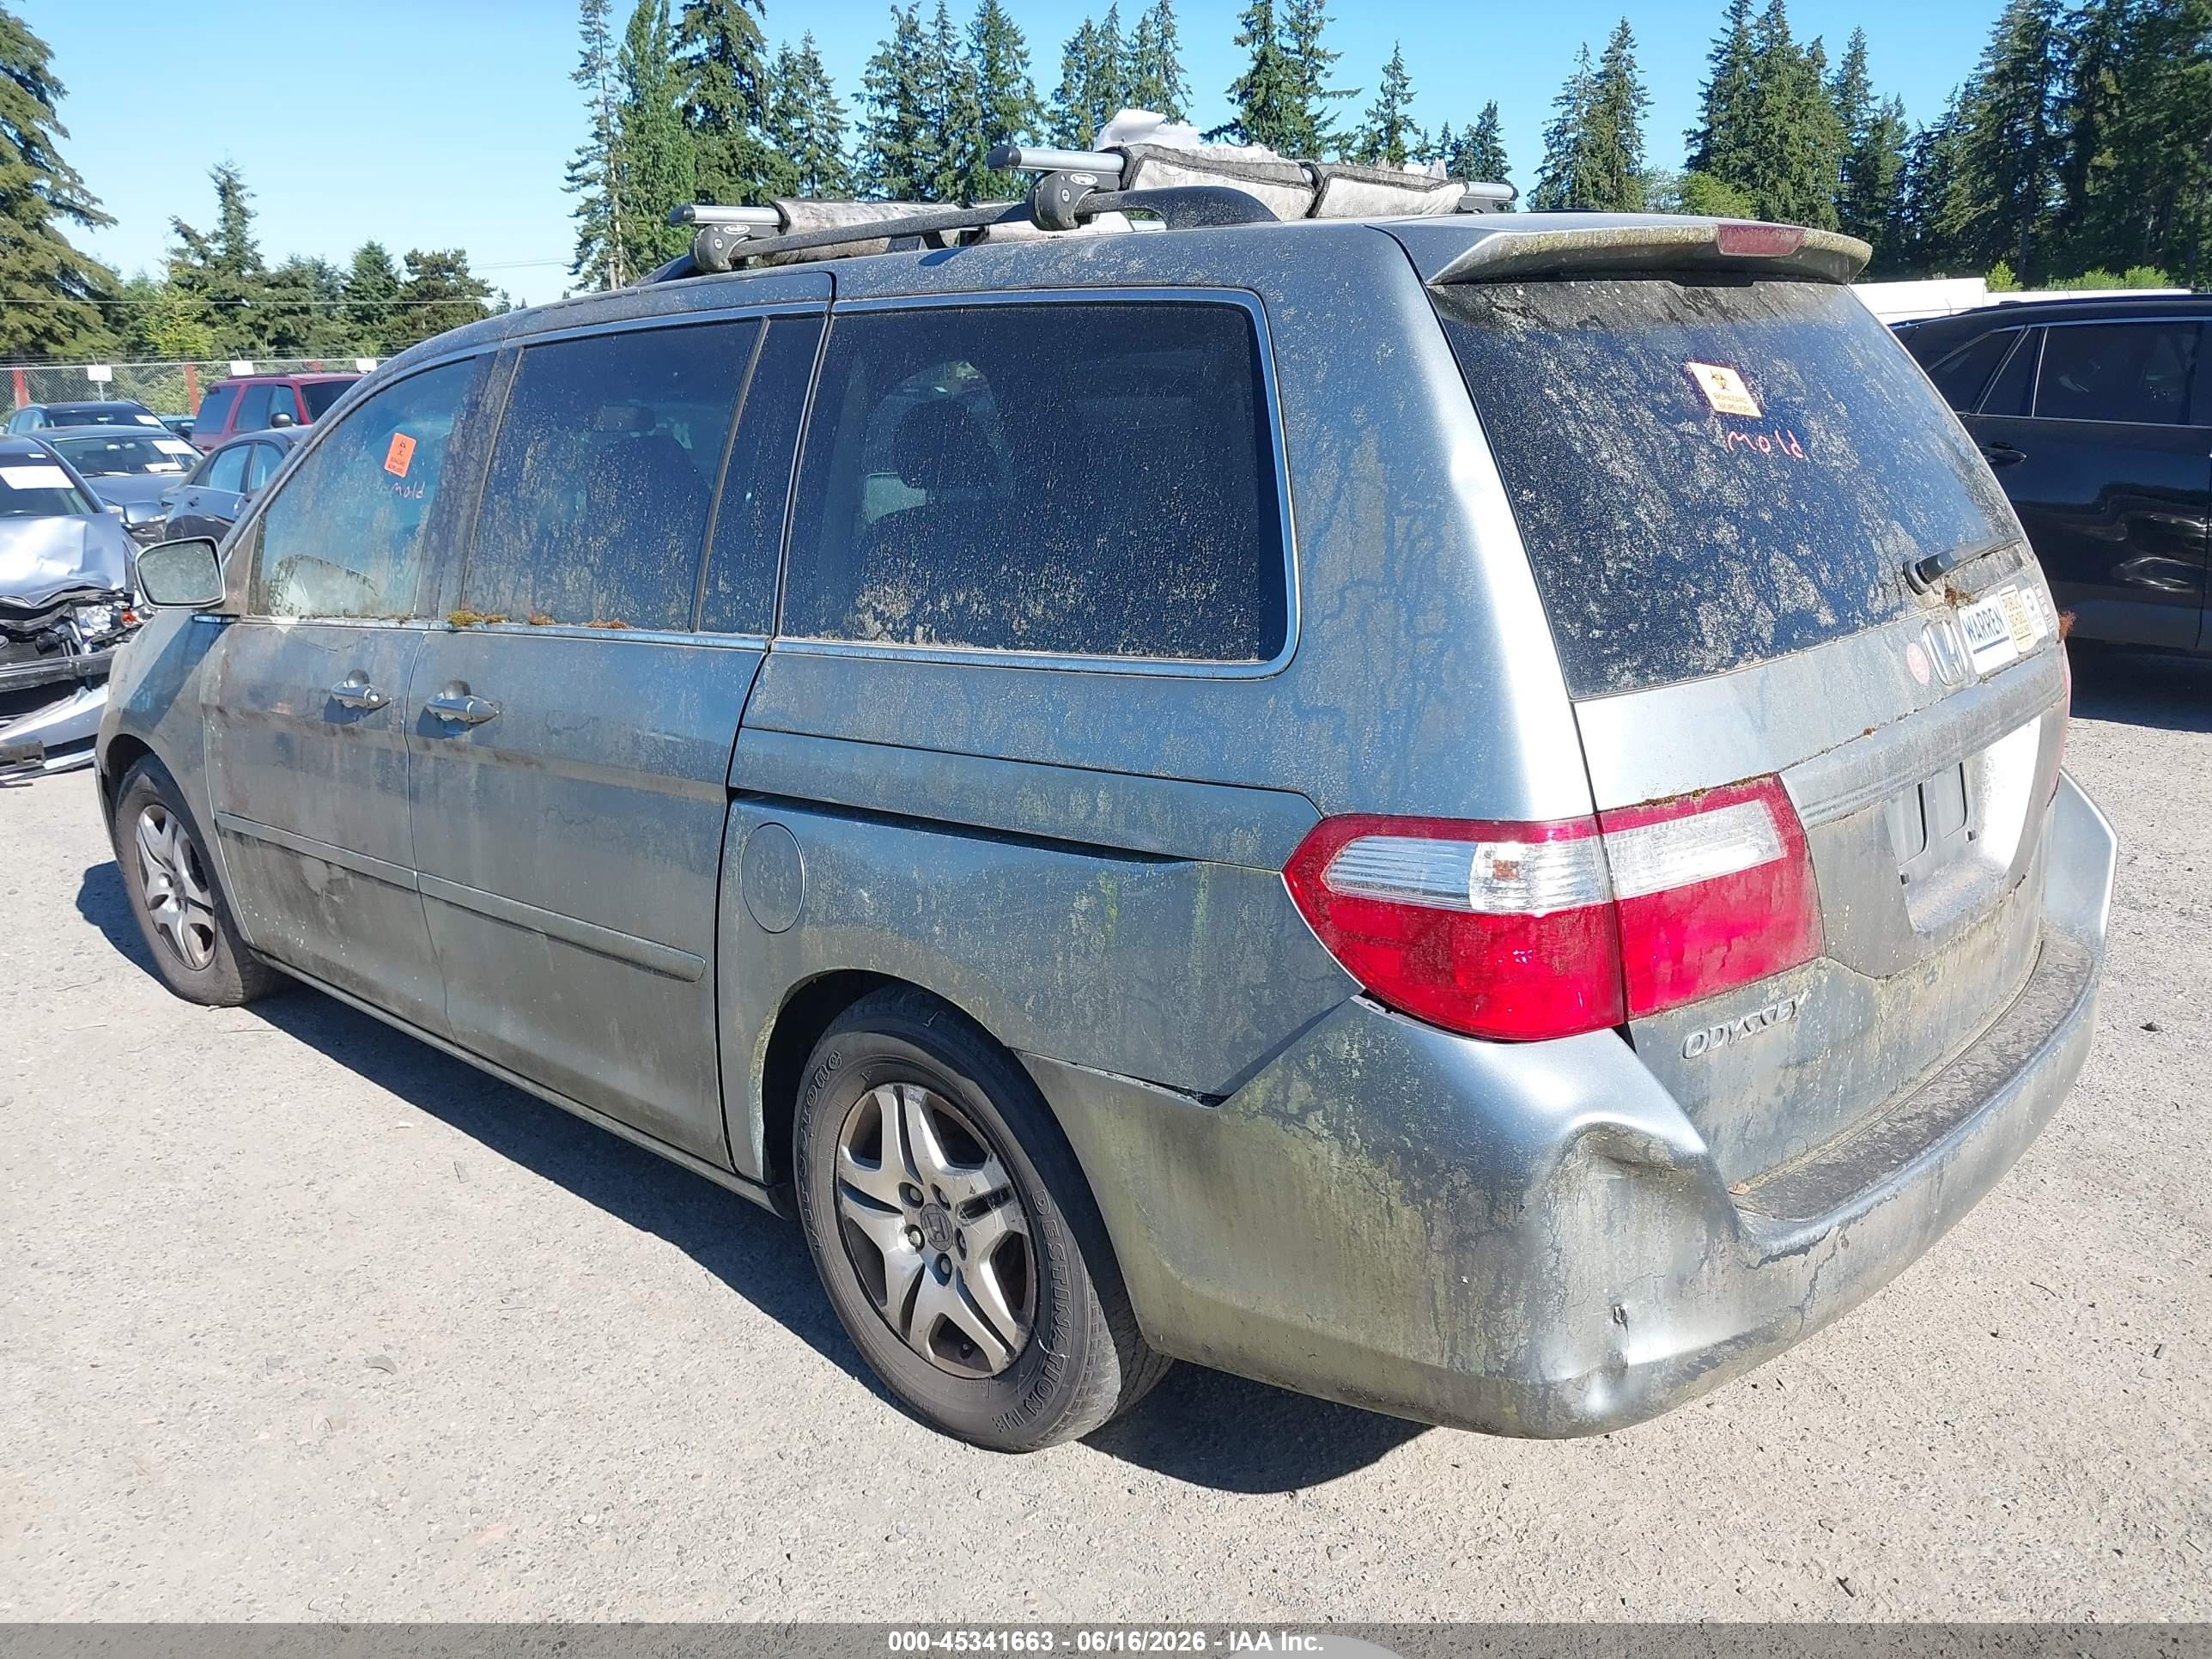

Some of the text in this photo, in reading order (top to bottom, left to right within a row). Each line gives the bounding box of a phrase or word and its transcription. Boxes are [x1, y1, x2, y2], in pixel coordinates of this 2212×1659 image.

[1961, 605, 2007, 644] WARREN
[1681, 988, 1812, 1060] ODYSSEY
[1024, 1188, 1073, 1417] DESTINATION
